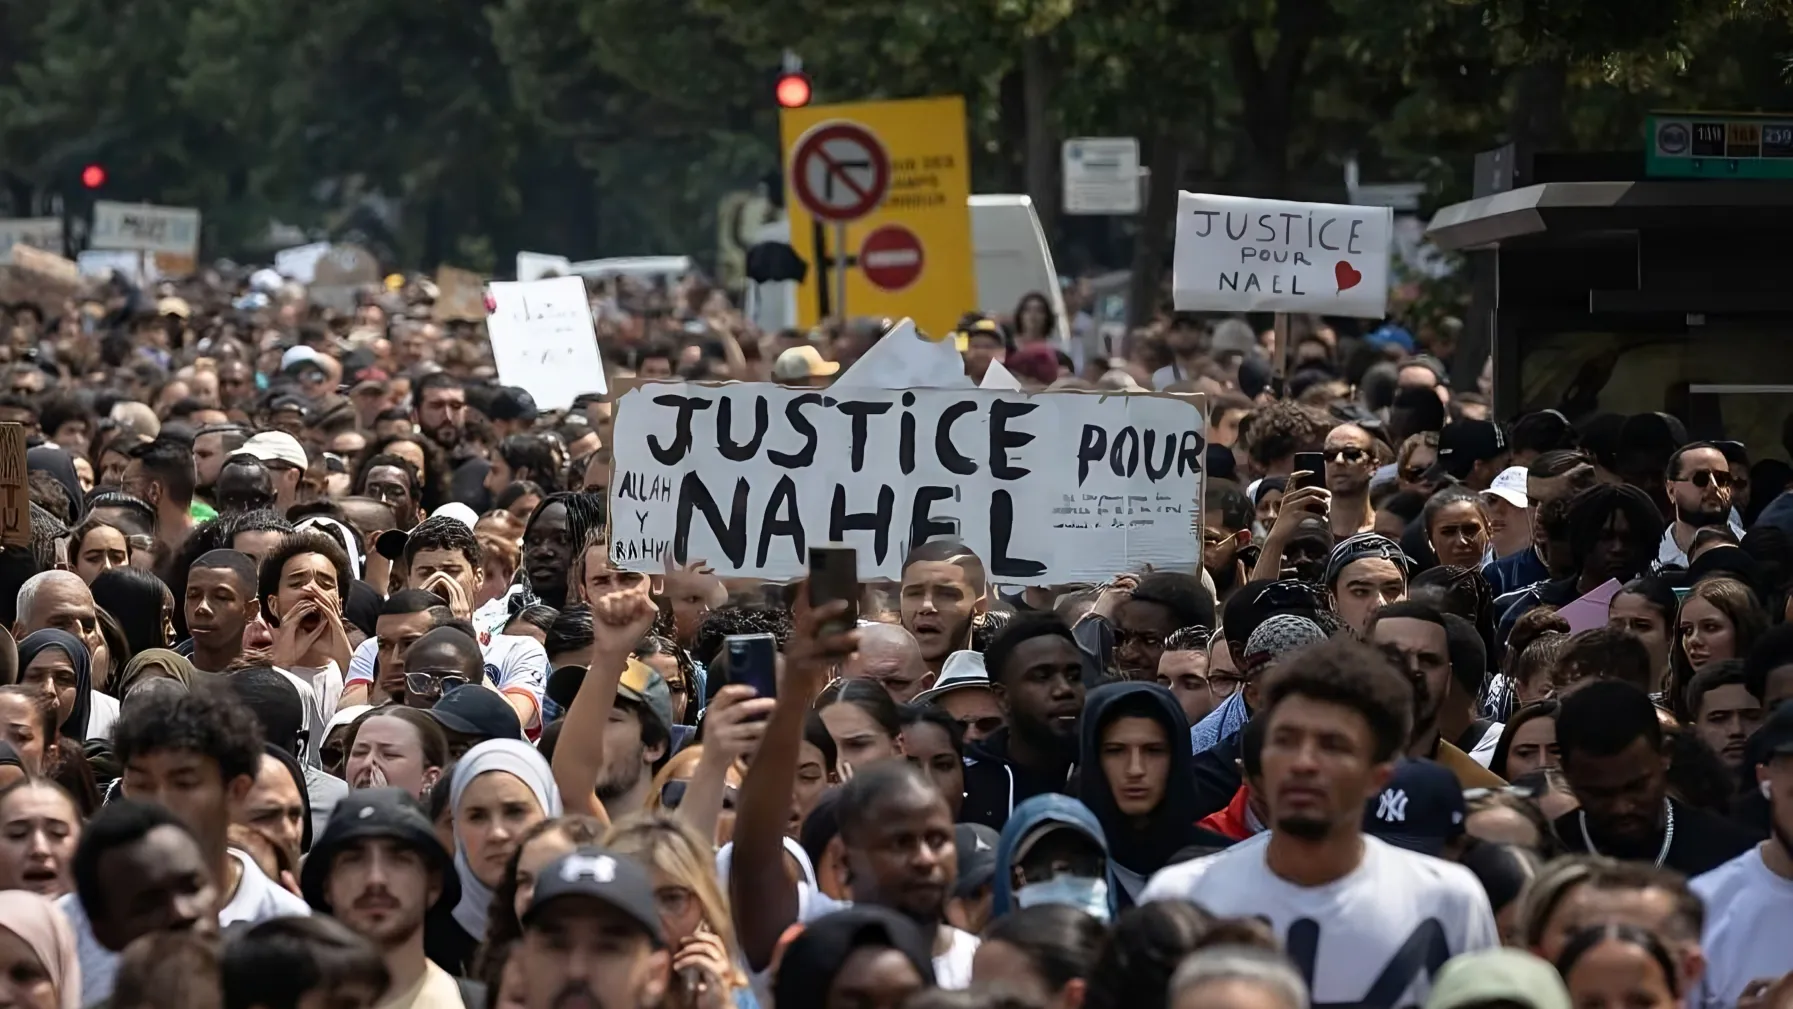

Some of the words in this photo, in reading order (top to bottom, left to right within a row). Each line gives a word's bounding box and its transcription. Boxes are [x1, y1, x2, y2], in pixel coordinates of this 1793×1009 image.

[1241, 247, 1312, 266] POUR
[1219, 271, 1305, 295] NAEL
[1077, 423, 1205, 489] POUR
[618, 470, 671, 502] ALLAH
[635, 510, 649, 534] Y
[674, 470, 1048, 578] NAHEL
